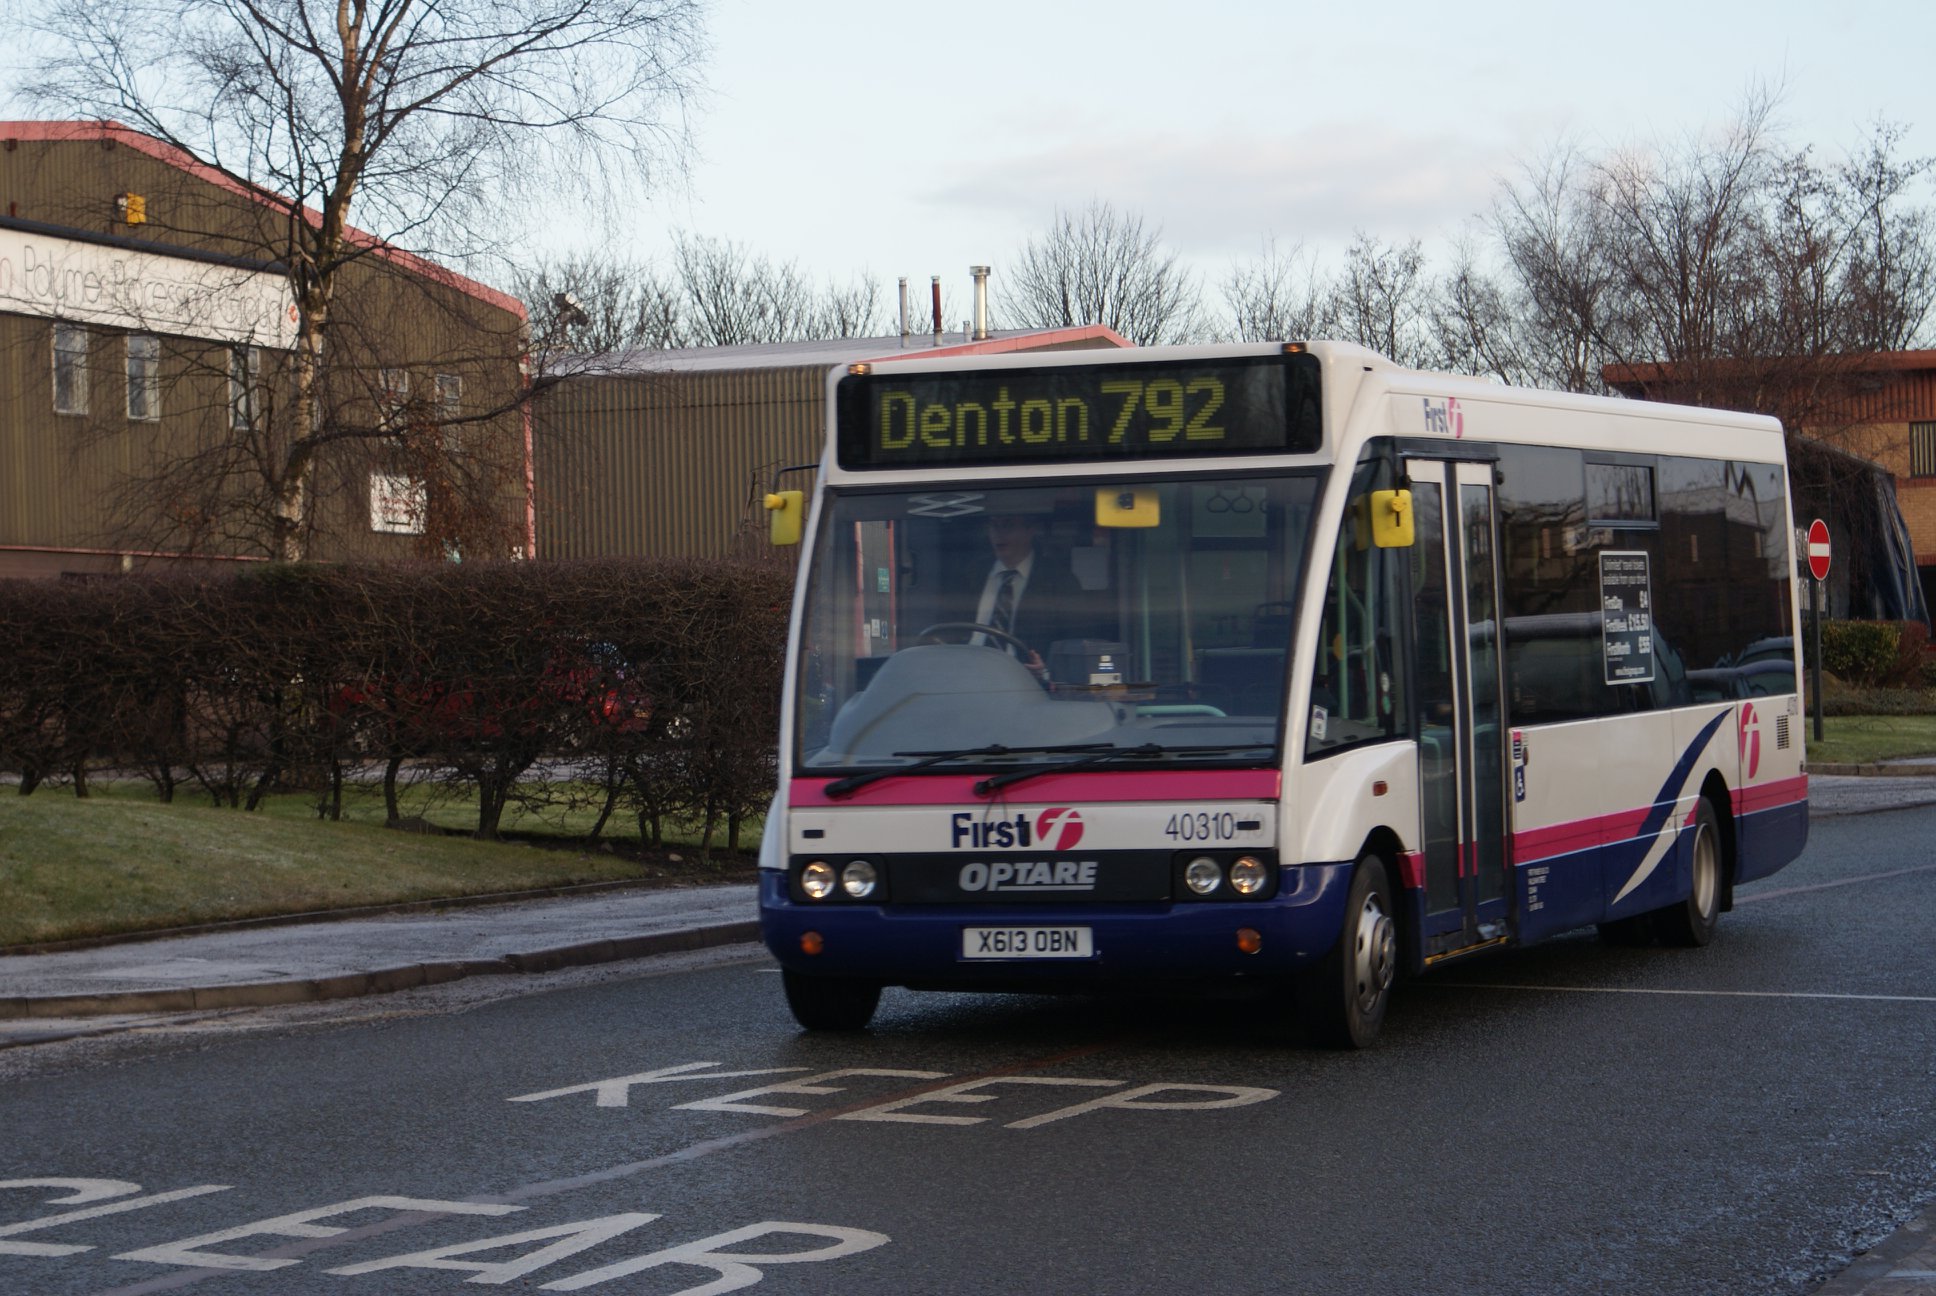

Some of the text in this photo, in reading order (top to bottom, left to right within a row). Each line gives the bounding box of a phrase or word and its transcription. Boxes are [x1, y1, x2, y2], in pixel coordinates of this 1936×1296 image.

[881, 378, 1226, 449] Denton 792
[952, 813, 1031, 848] First
[1165, 812, 1235, 840] 40310
[959, 862, 1098, 891] OPTARE
[978, 930, 1078, 952] X613 OBN
[506, 1062, 1282, 1129] KEEP
